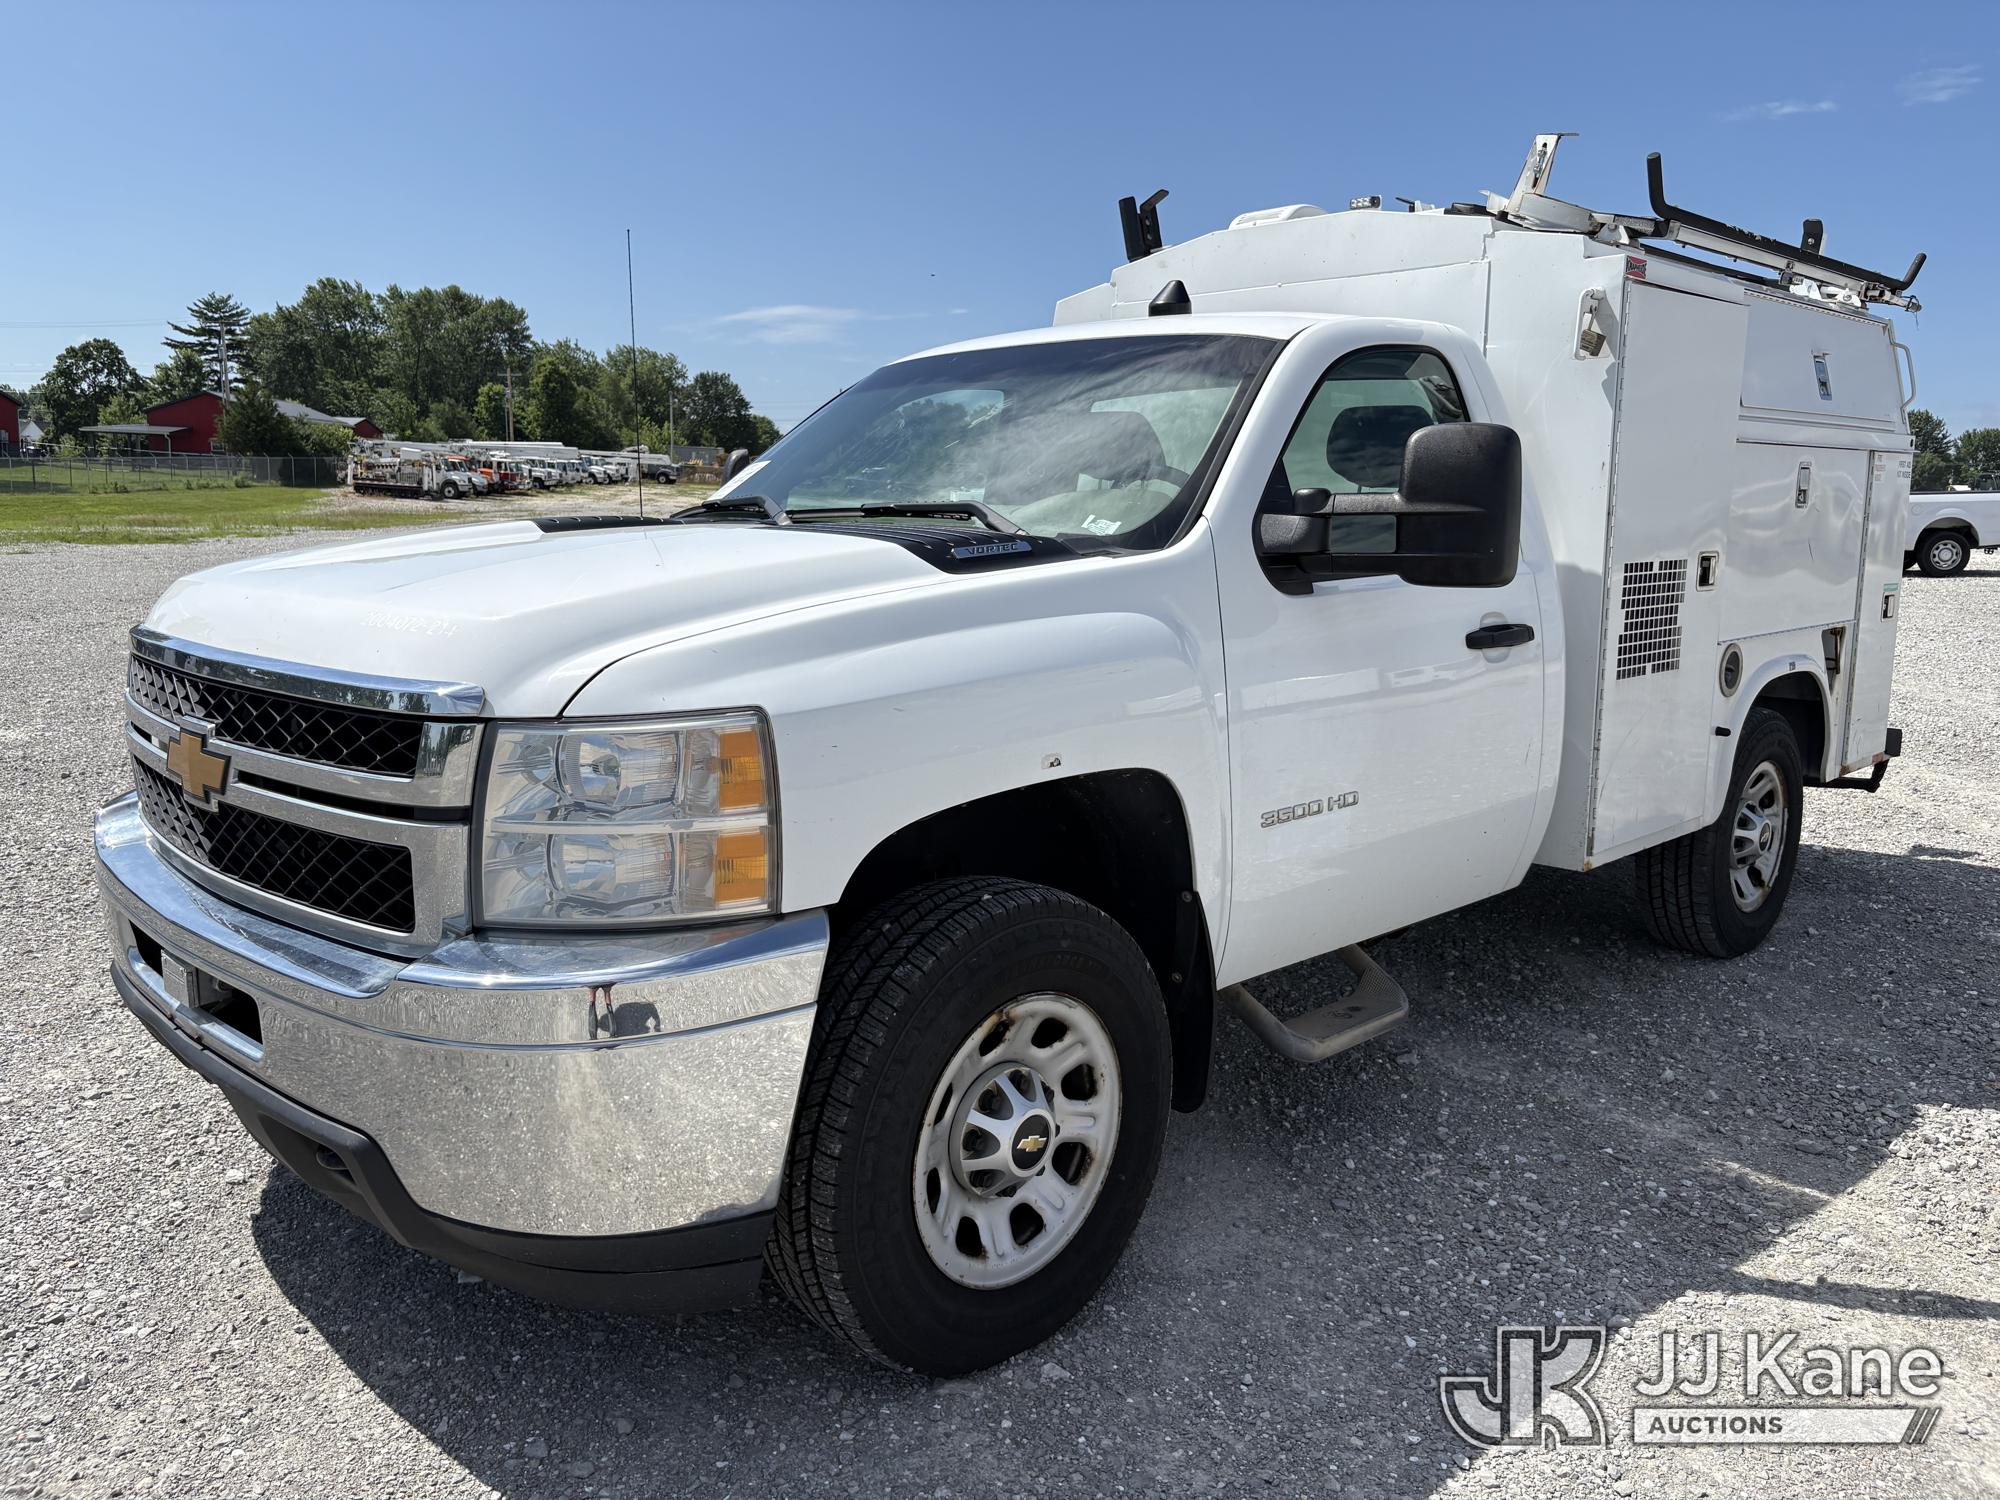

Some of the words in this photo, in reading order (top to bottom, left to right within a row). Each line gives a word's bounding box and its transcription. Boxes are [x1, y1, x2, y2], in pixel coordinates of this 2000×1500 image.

[965, 543, 1018, 555] VORTEC
[1260, 799, 1323, 828] 3500
[1328, 790, 1360, 812] HD
